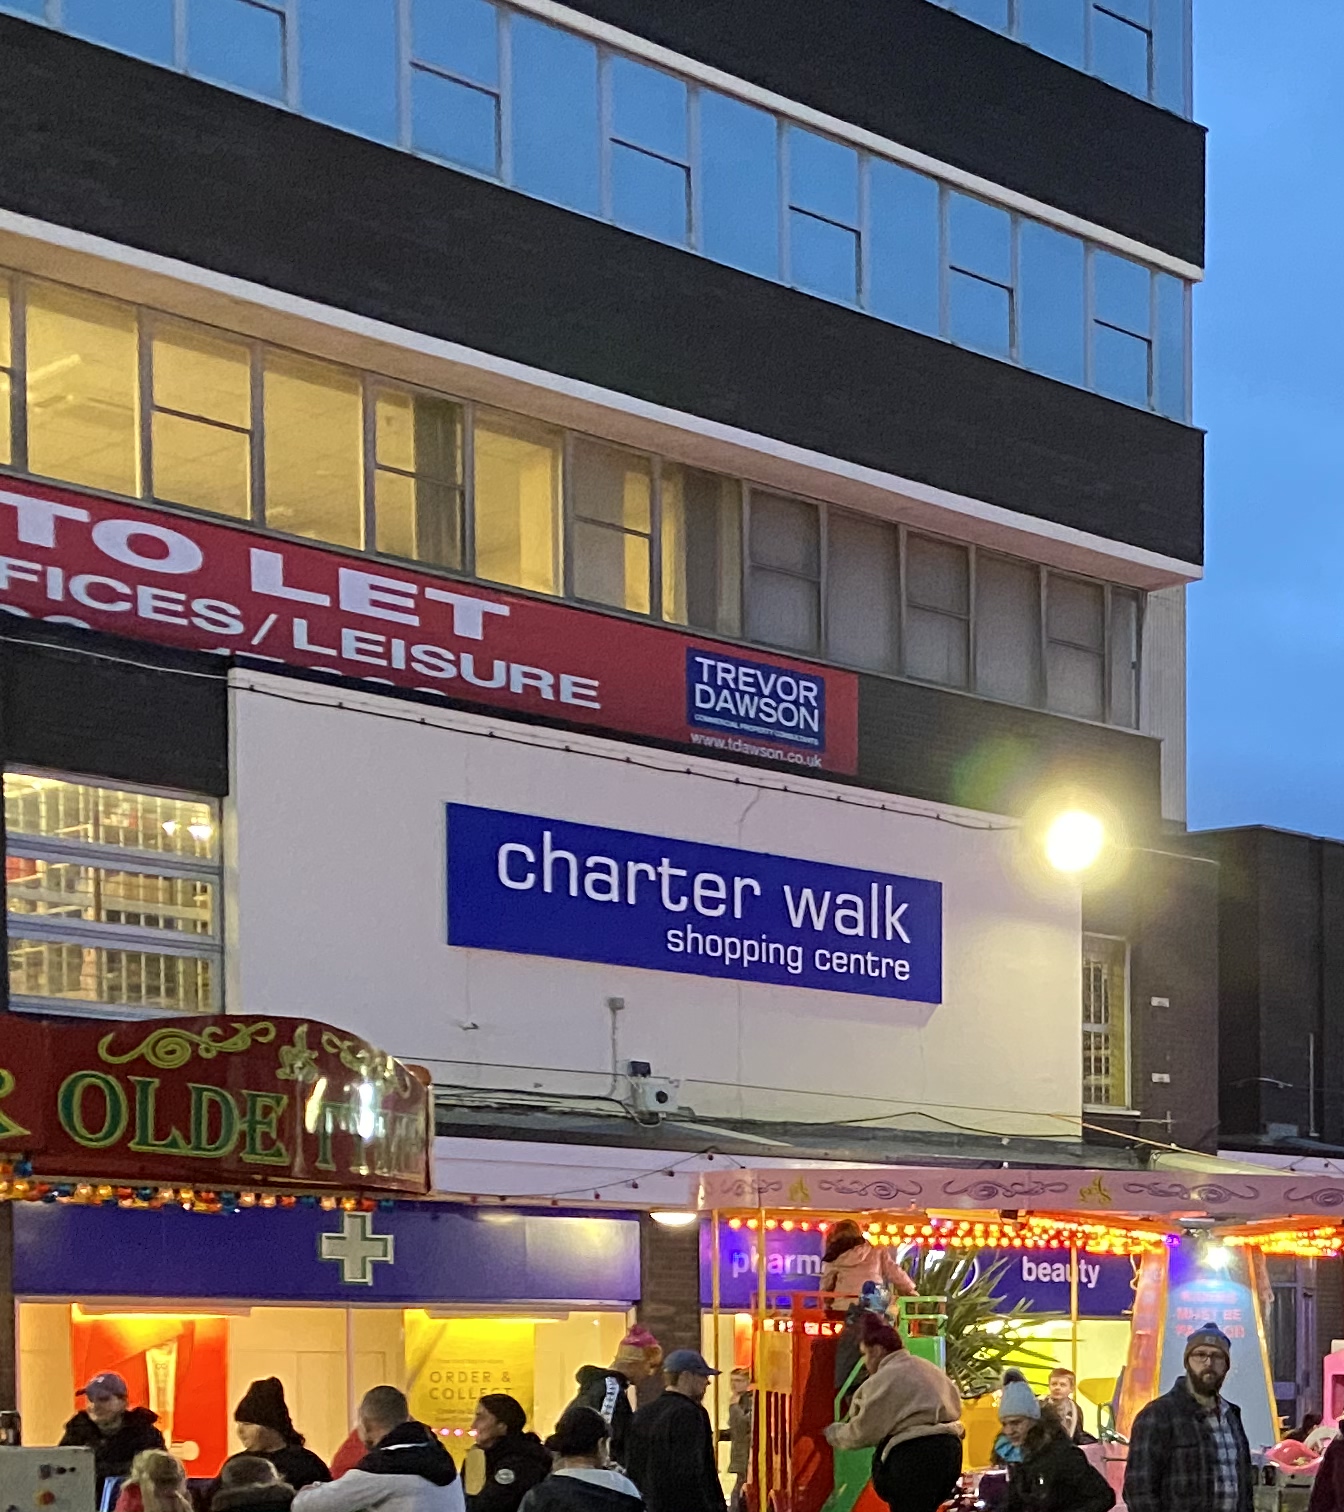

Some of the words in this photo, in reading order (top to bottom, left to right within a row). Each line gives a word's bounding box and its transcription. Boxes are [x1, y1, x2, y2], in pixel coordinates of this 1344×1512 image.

[0, 490, 203, 574] TO
[249, 547, 510, 640] LET
[694, 656, 818, 706] TREVOR
[694, 683, 819, 732] DAWSON
[690, 732, 823, 768] www.tdawson.co.uk
[497, 830, 762, 919] charter
[783, 882, 912, 944] walk
[666, 924, 803, 974] shopping
[813, 947, 911, 981] centre
[57, 1069, 291, 1167] OLDE
[732, 1245, 823, 1278] pharm
[1022, 1255, 1100, 1288] beauty
[430, 1371, 491, 1384] ORDER
[501, 1371, 511, 1383] &
